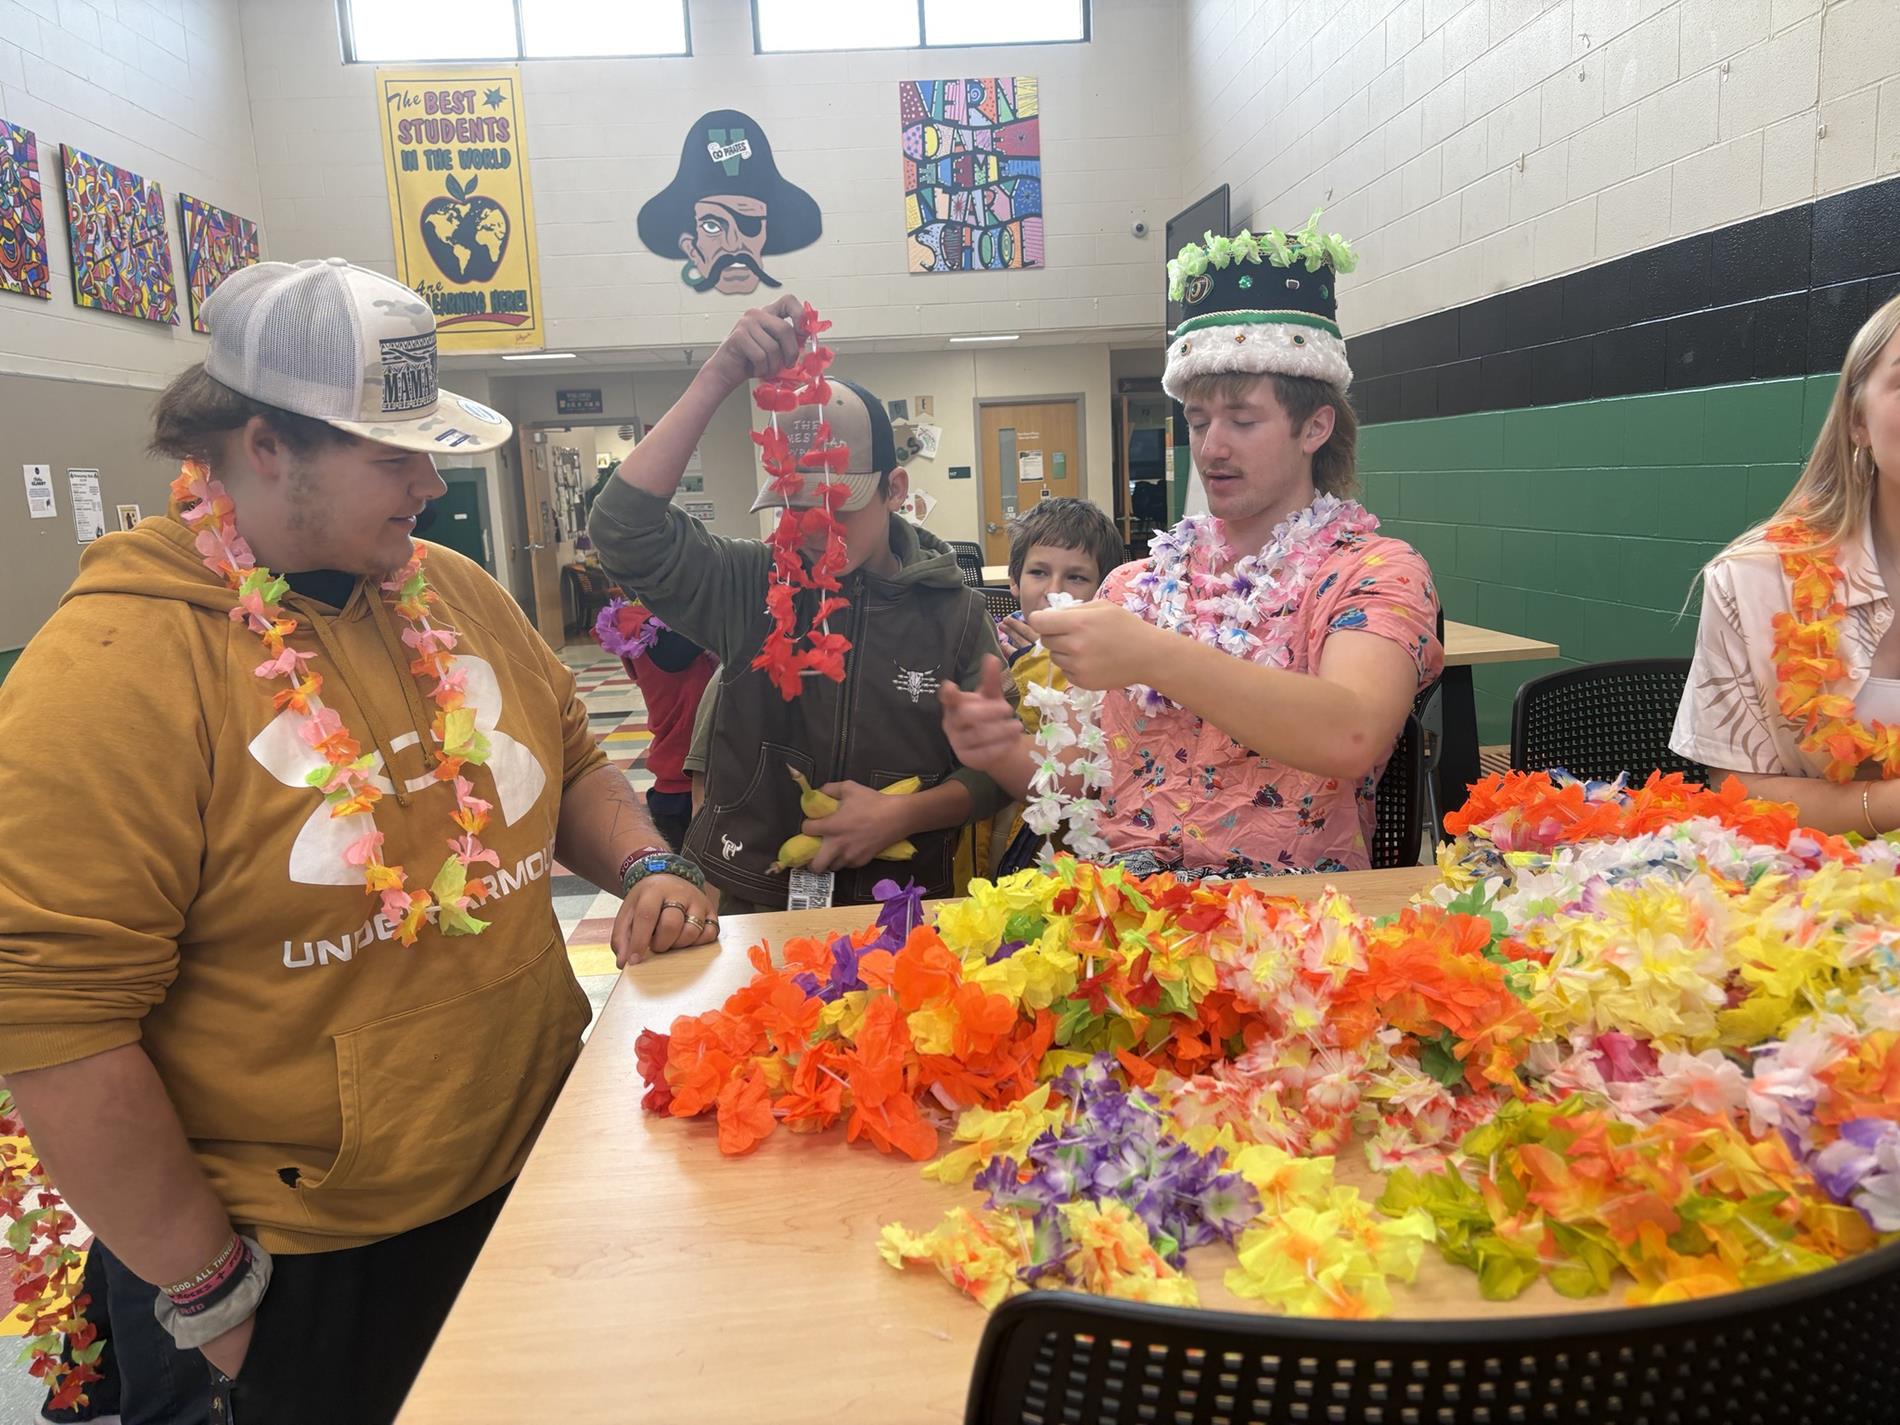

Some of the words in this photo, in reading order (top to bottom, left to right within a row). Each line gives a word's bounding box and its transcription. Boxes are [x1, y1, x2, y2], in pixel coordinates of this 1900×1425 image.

[387, 90, 421, 111] The
[424, 90, 477, 115] BEST
[398, 117, 511, 145] STUDENTS
[400, 150, 419, 172] IN
[423, 148, 454, 171] THE
[457, 147, 512, 170] WORLD
[723, 141, 747, 157] PIRATES
[414, 279, 444, 296] Are
[793, 420, 820, 430] THE
[282, 902, 439, 968] UNDE
[172, 1281, 195, 1293] GOD,
[195, 1268, 214, 1283] ALL
